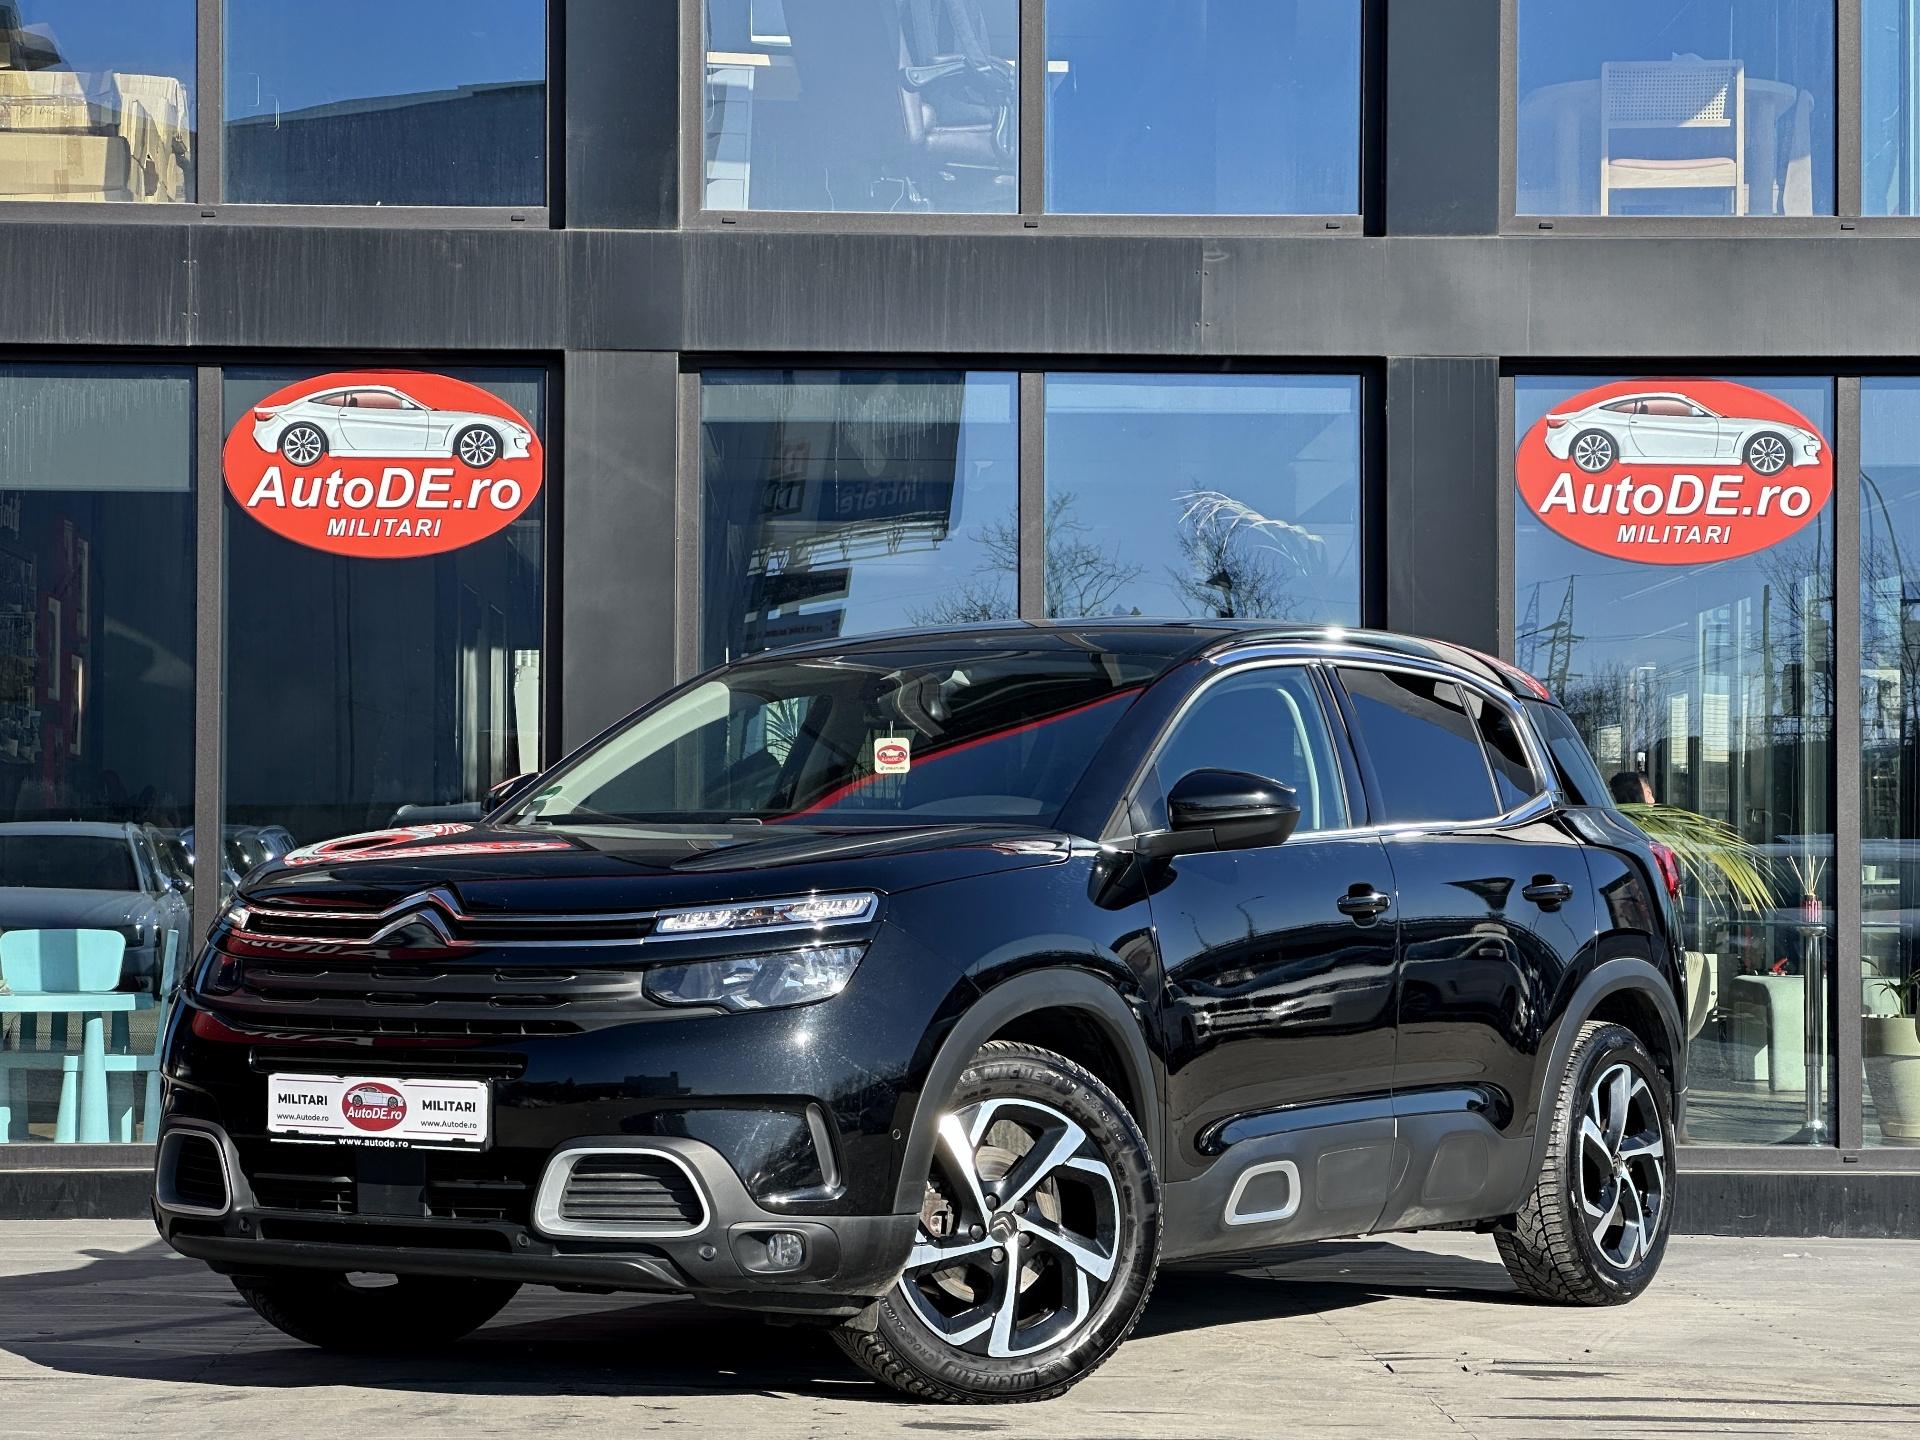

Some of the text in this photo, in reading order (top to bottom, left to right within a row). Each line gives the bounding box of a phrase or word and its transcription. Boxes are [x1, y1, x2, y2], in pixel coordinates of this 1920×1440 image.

[247, 466, 522, 510] AutoDE.ro
[1538, 472, 1812, 517] AutoDE.ro
[327, 518, 441, 537] MILITARI
[1617, 525, 1731, 544] MILITARI
[277, 1093, 328, 1106] MILITARI
[422, 1100, 476, 1113] MILITARI
[276, 1113, 330, 1122] www.Autode.ro
[347, 1106, 403, 1121] AutoDE.ro
[420, 1119, 478, 1129] www.Autode.ro
[338, 1137, 409, 1149] www.autode.ro
